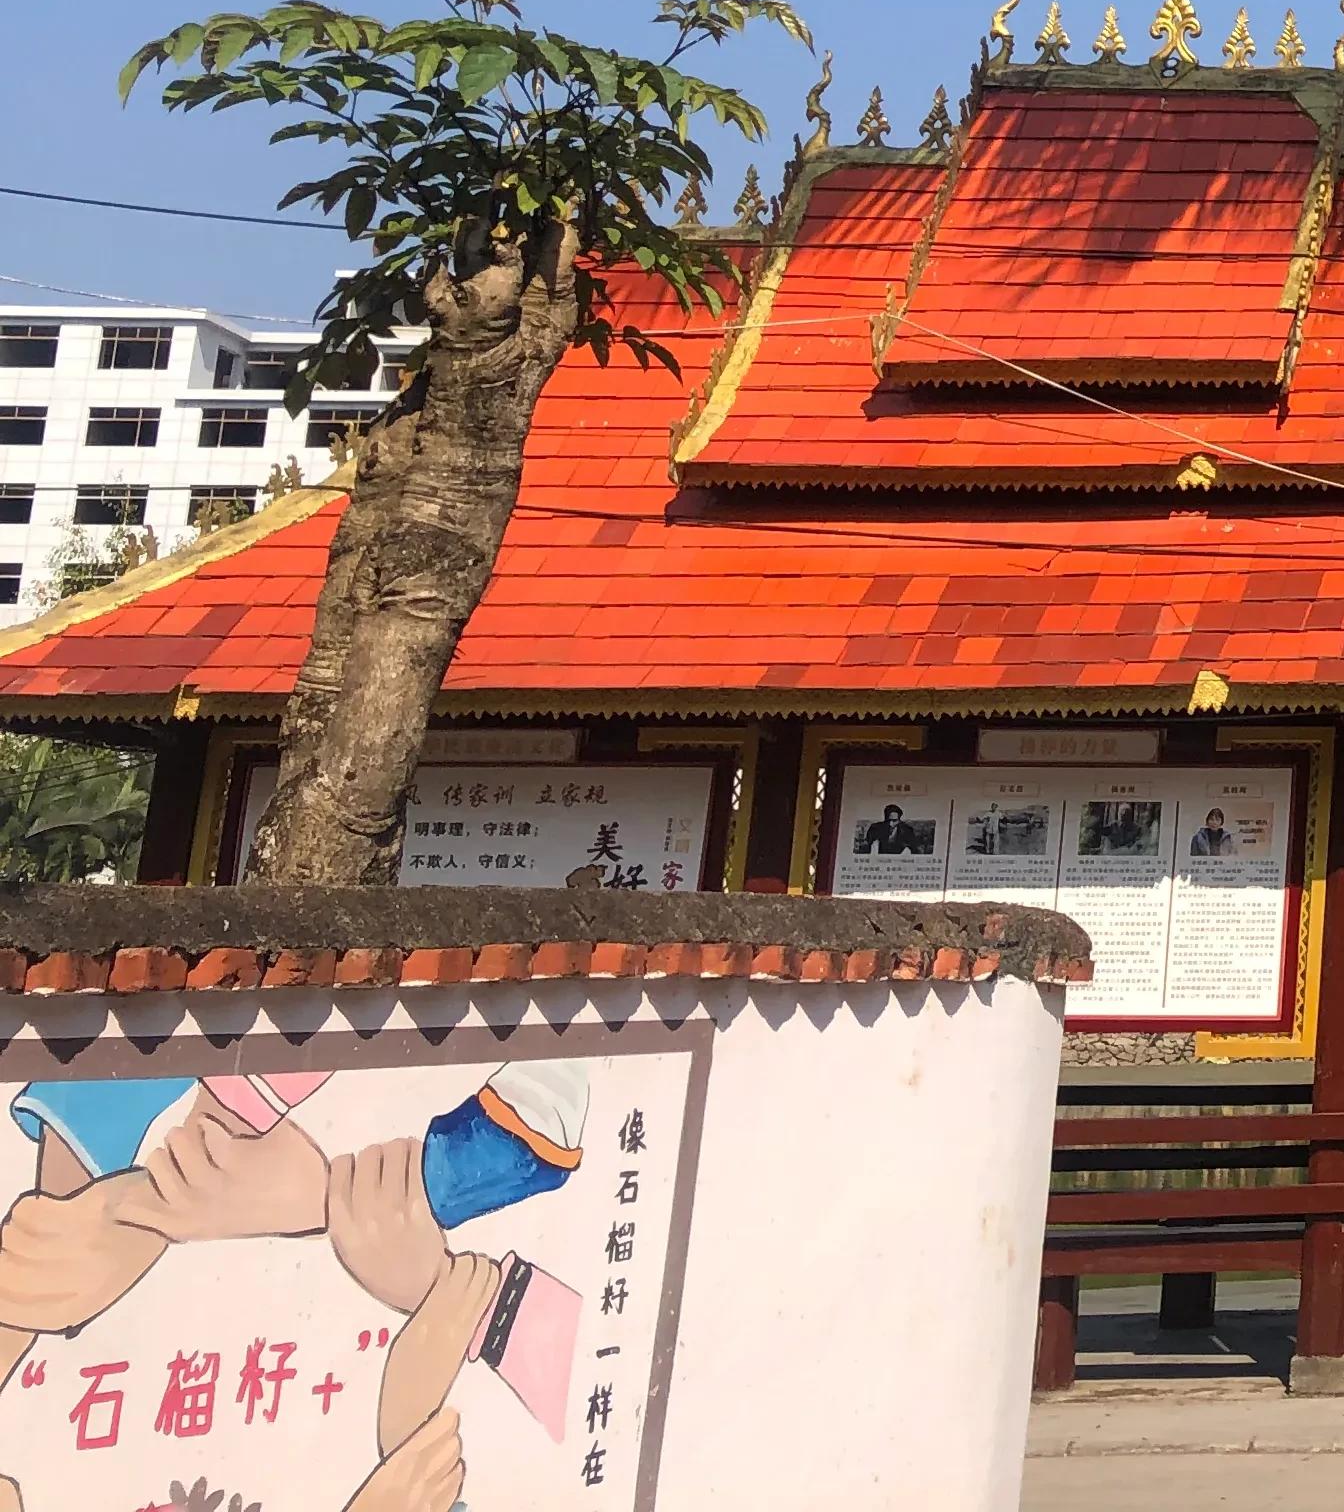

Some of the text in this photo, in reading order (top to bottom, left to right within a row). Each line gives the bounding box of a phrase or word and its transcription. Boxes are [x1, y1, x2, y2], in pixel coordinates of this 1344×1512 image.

[443, 783, 515, 808] 传家训
[535, 783, 609, 808] 立家规
[580, 1107, 648, 1488] 像石榴籽一样在
